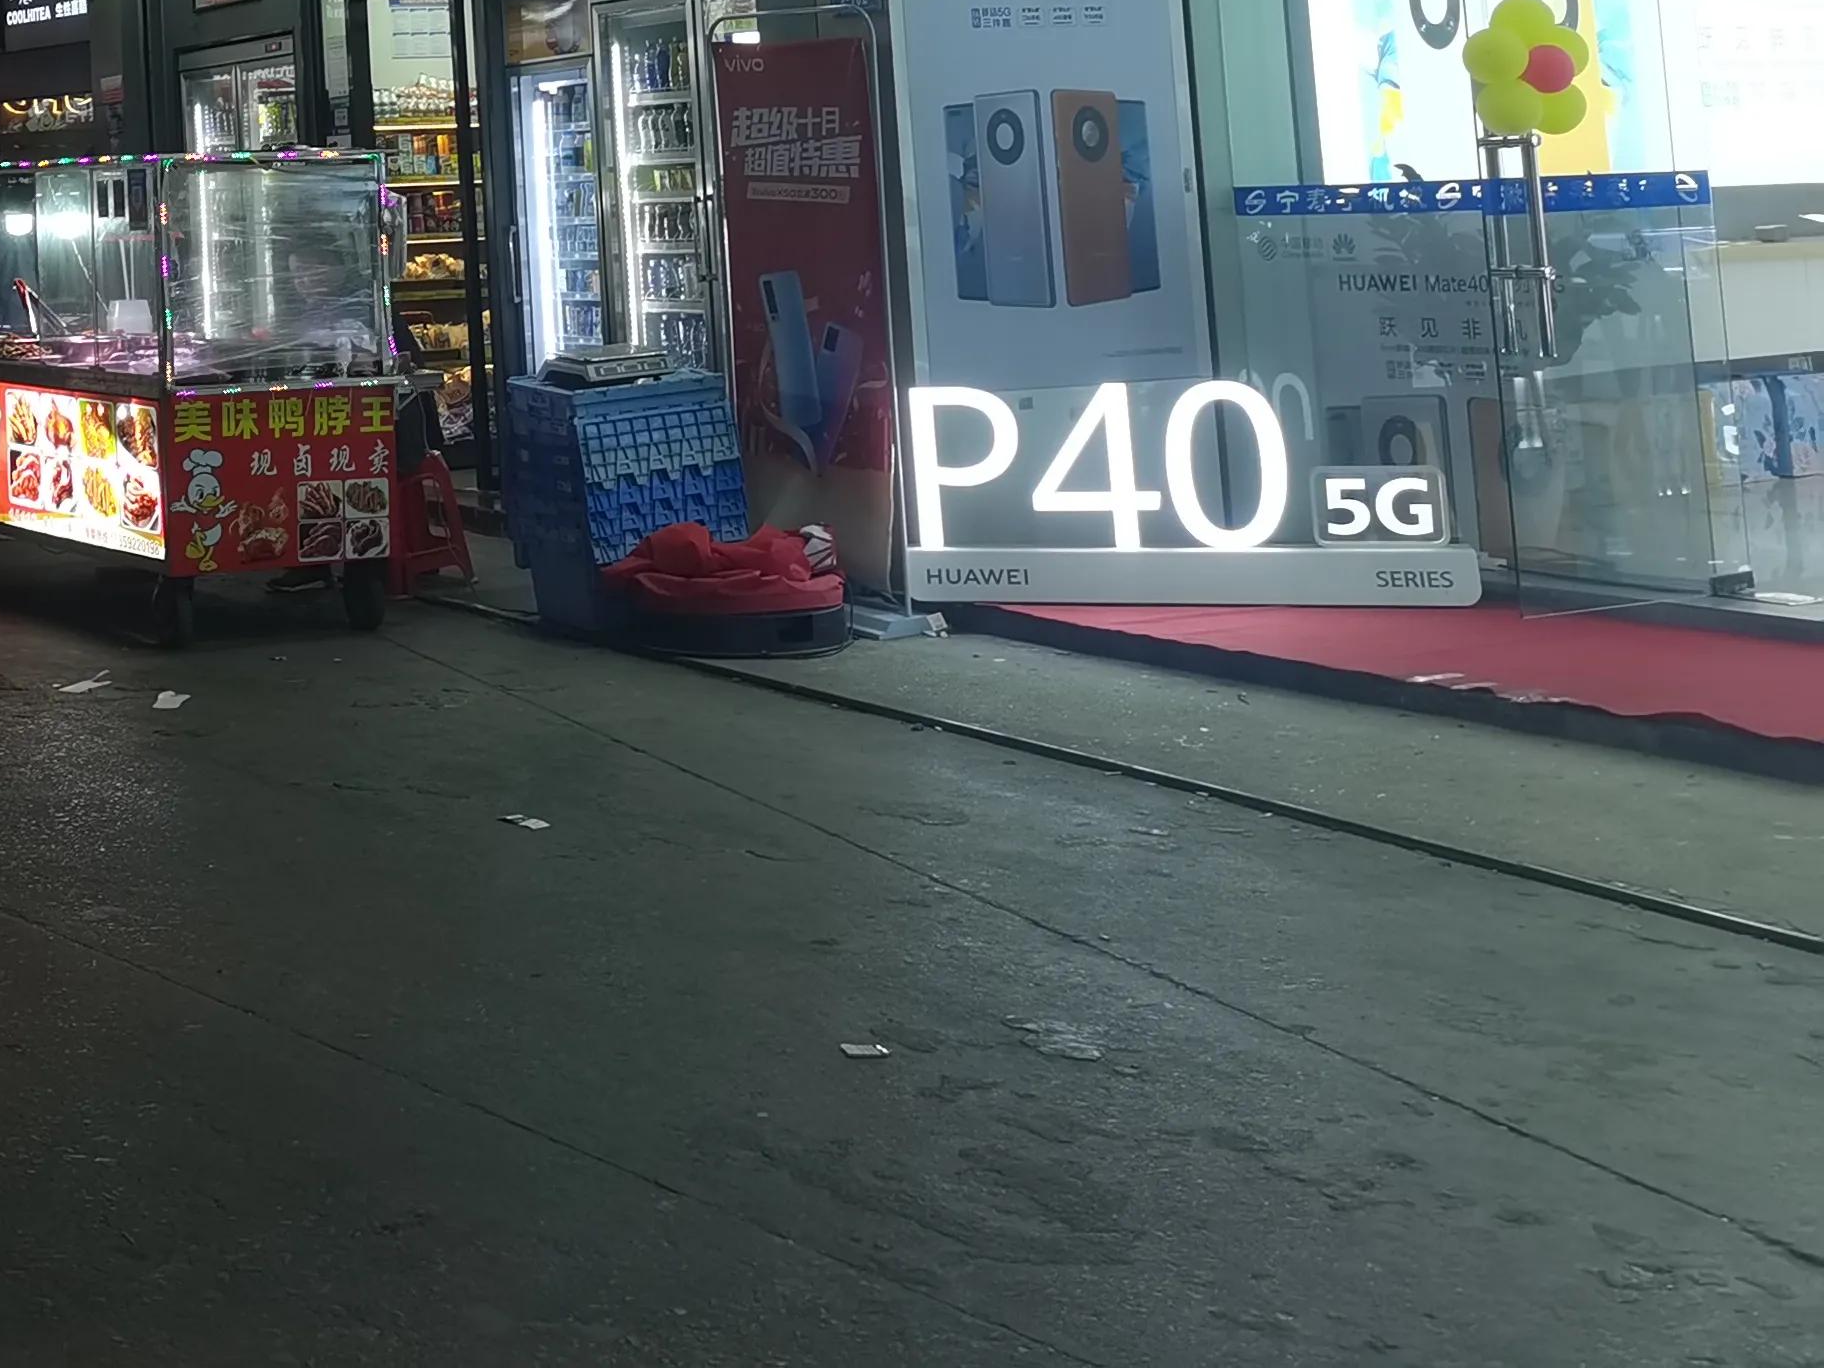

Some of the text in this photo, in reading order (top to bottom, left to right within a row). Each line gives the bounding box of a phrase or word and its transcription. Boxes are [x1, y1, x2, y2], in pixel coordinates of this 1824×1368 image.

[724, 54, 765, 72] vivo
[730, 106, 840, 148] 超级十月
[744, 134, 862, 178] 超值特惠
[1337, 274, 1418, 293] HUAWEI
[1424, 273, 1489, 293] Mate40
[174, 395, 394, 442] 美味鸭脖王
[250, 439, 392, 477] 现卤现卖
[908, 380, 1288, 552] P40
[1324, 477, 1435, 536] 5G
[926, 567, 1029, 586] HUAWEI
[1376, 570, 1454, 590] SERIES
